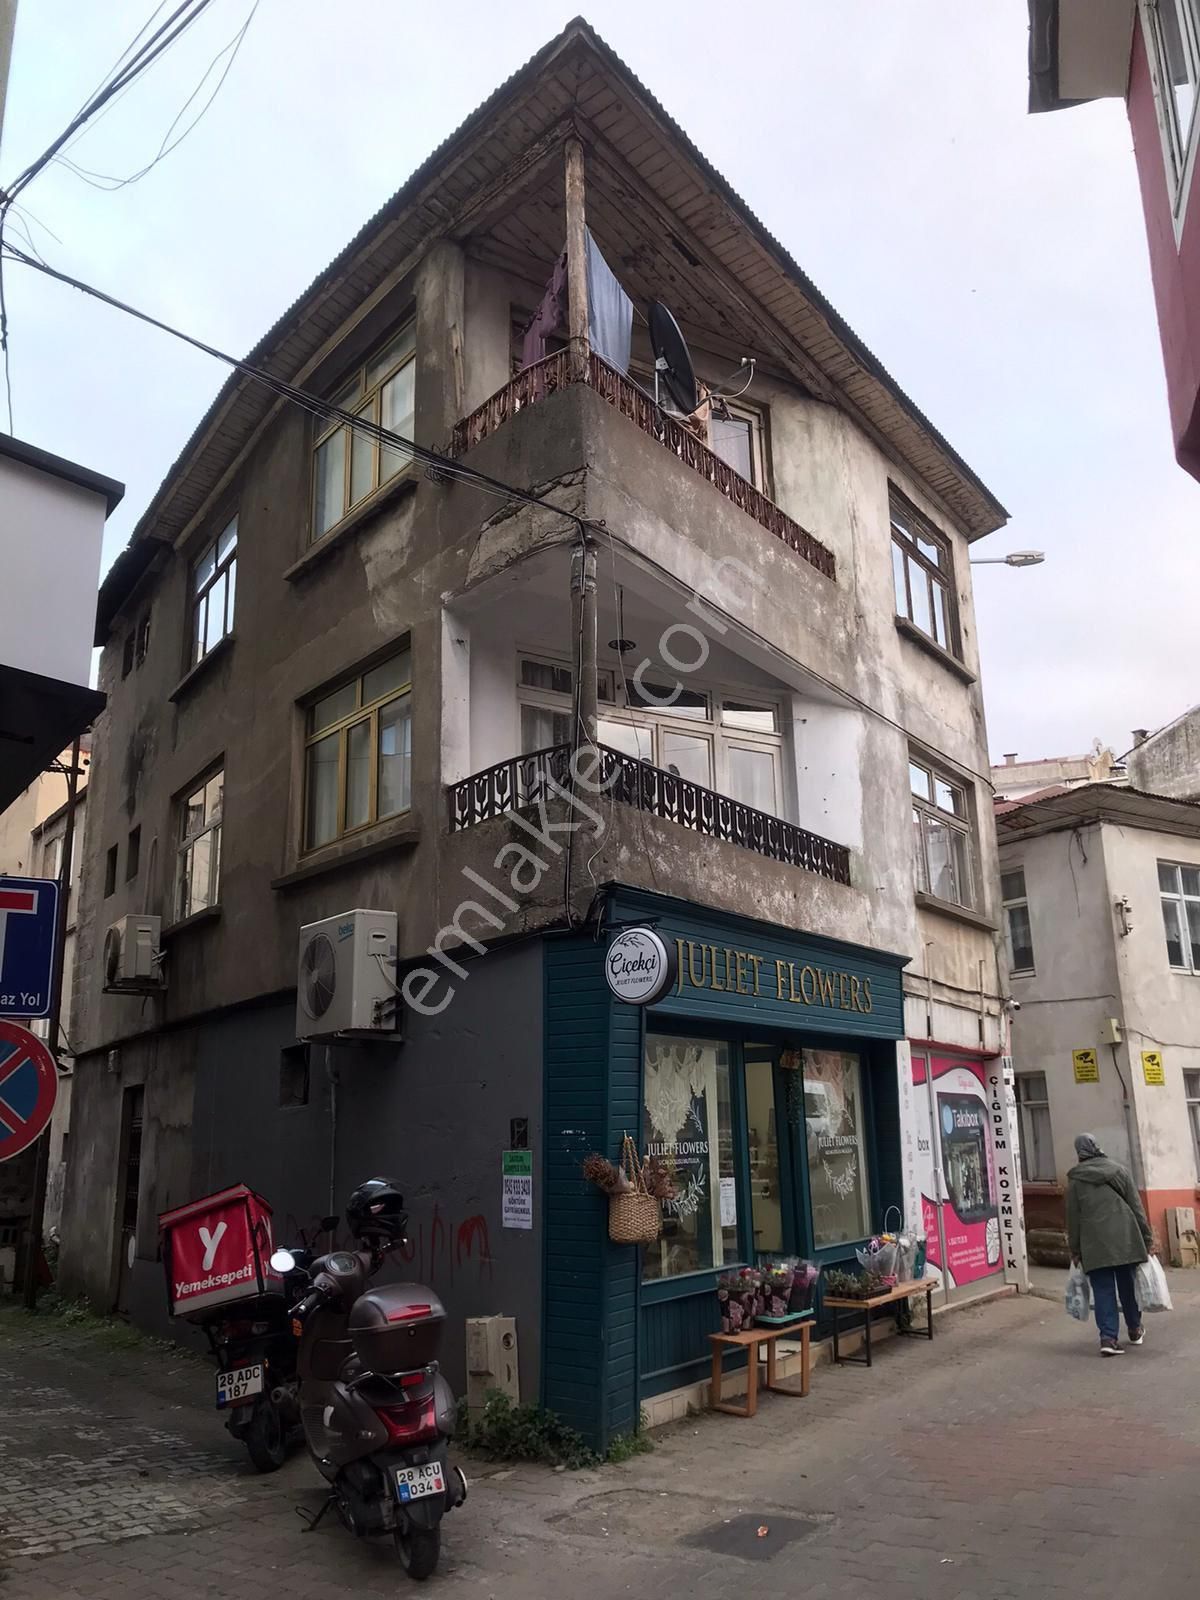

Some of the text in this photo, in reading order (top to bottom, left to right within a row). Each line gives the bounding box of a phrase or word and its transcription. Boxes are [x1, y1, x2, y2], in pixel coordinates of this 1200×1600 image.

[609, 951, 658, 979] Çiçekçi
[675, 938, 872, 1014] JULIET FLOWERS
[20, 992, 40, 1006] Yol
[647, 1140, 709, 1157] JULIET FLOWERS
[989, 1076, 1007, 1149] ÇİĞDEM
[998, 1166, 1017, 1269] KOZMETİK
[198, 1221, 228, 1271] Y
[175, 1263, 252, 1298] Yemeksepeti
[219, 1366, 260, 1388] 28 ADC
[228, 1382, 249, 1399] 187
[398, 1464, 440, 1483] 28 ACU
[410, 1481, 433, 1495] 034
